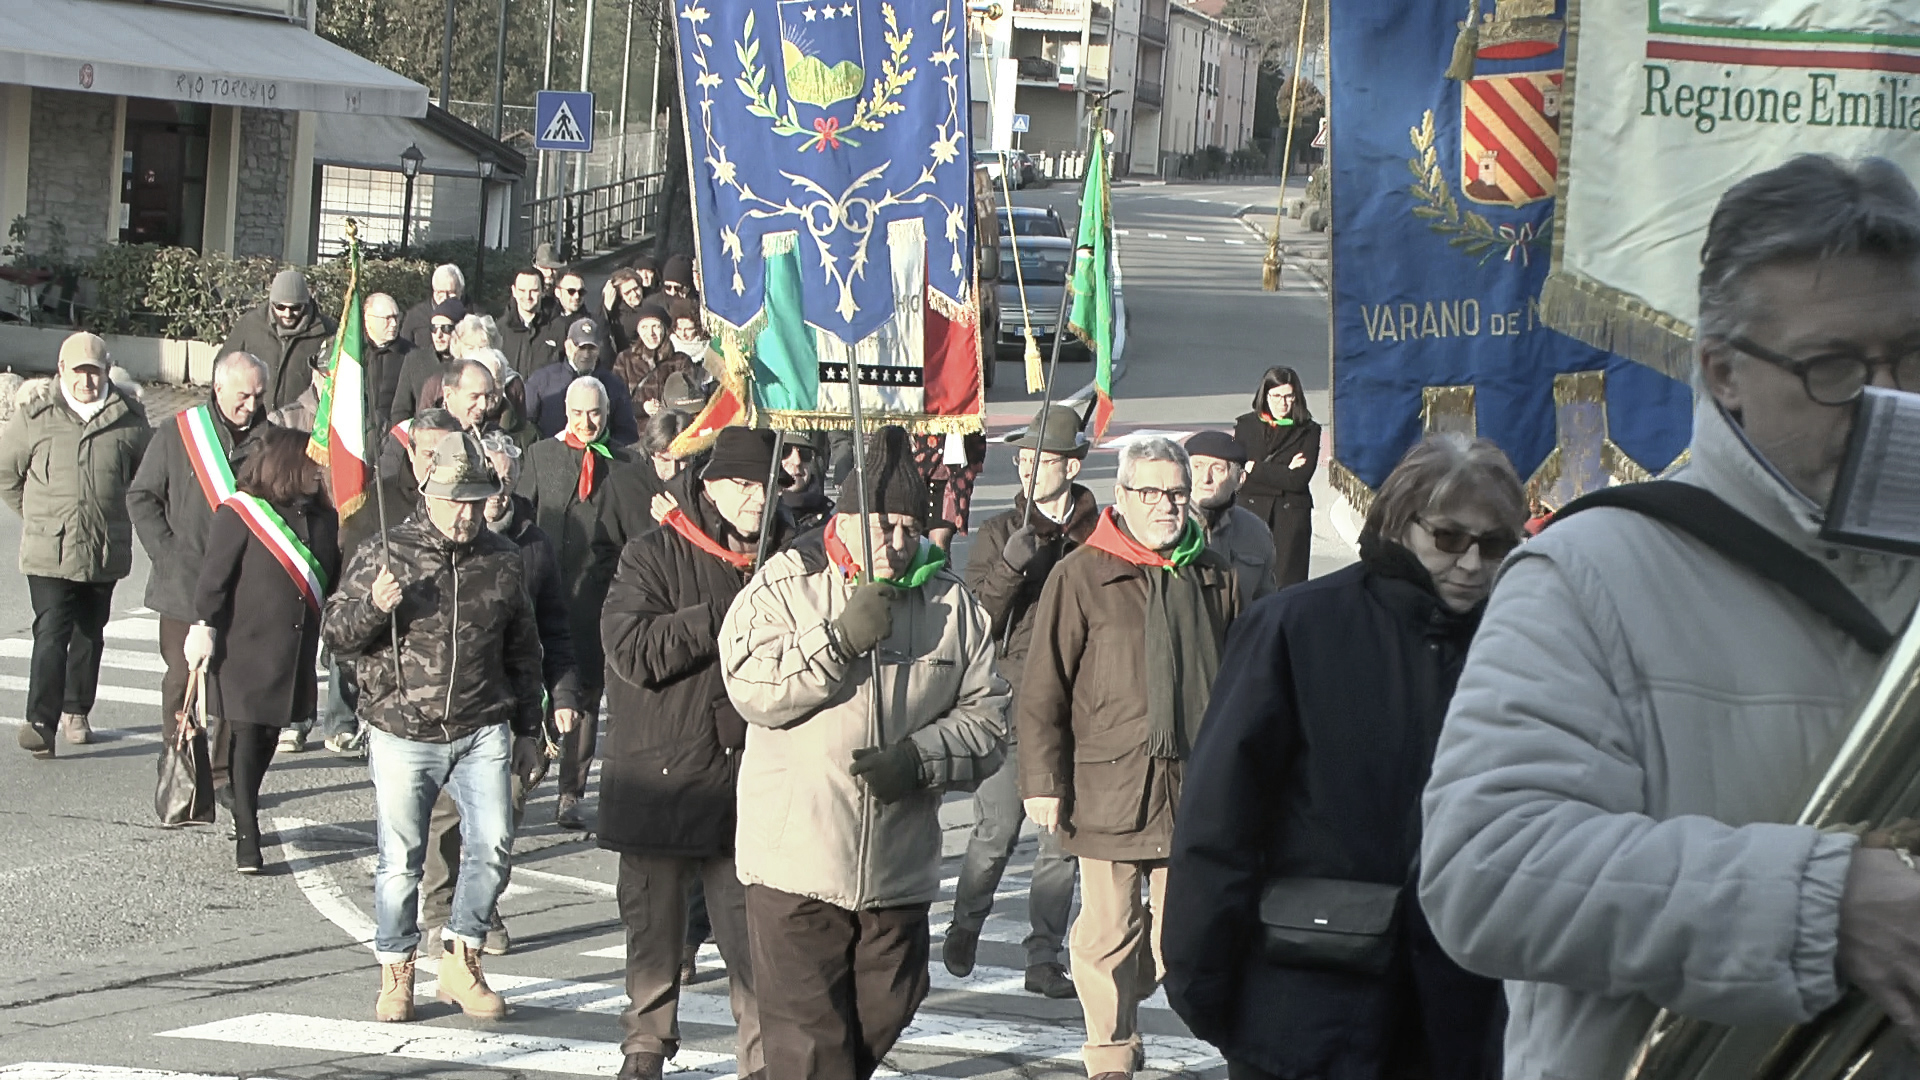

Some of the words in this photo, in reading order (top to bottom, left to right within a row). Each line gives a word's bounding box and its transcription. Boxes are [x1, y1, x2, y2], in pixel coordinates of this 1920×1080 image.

[1641, 64, 1802, 134] Regione
[1806, 73, 1920, 132] Emilia
[1361, 299, 1480, 341] VARANO
